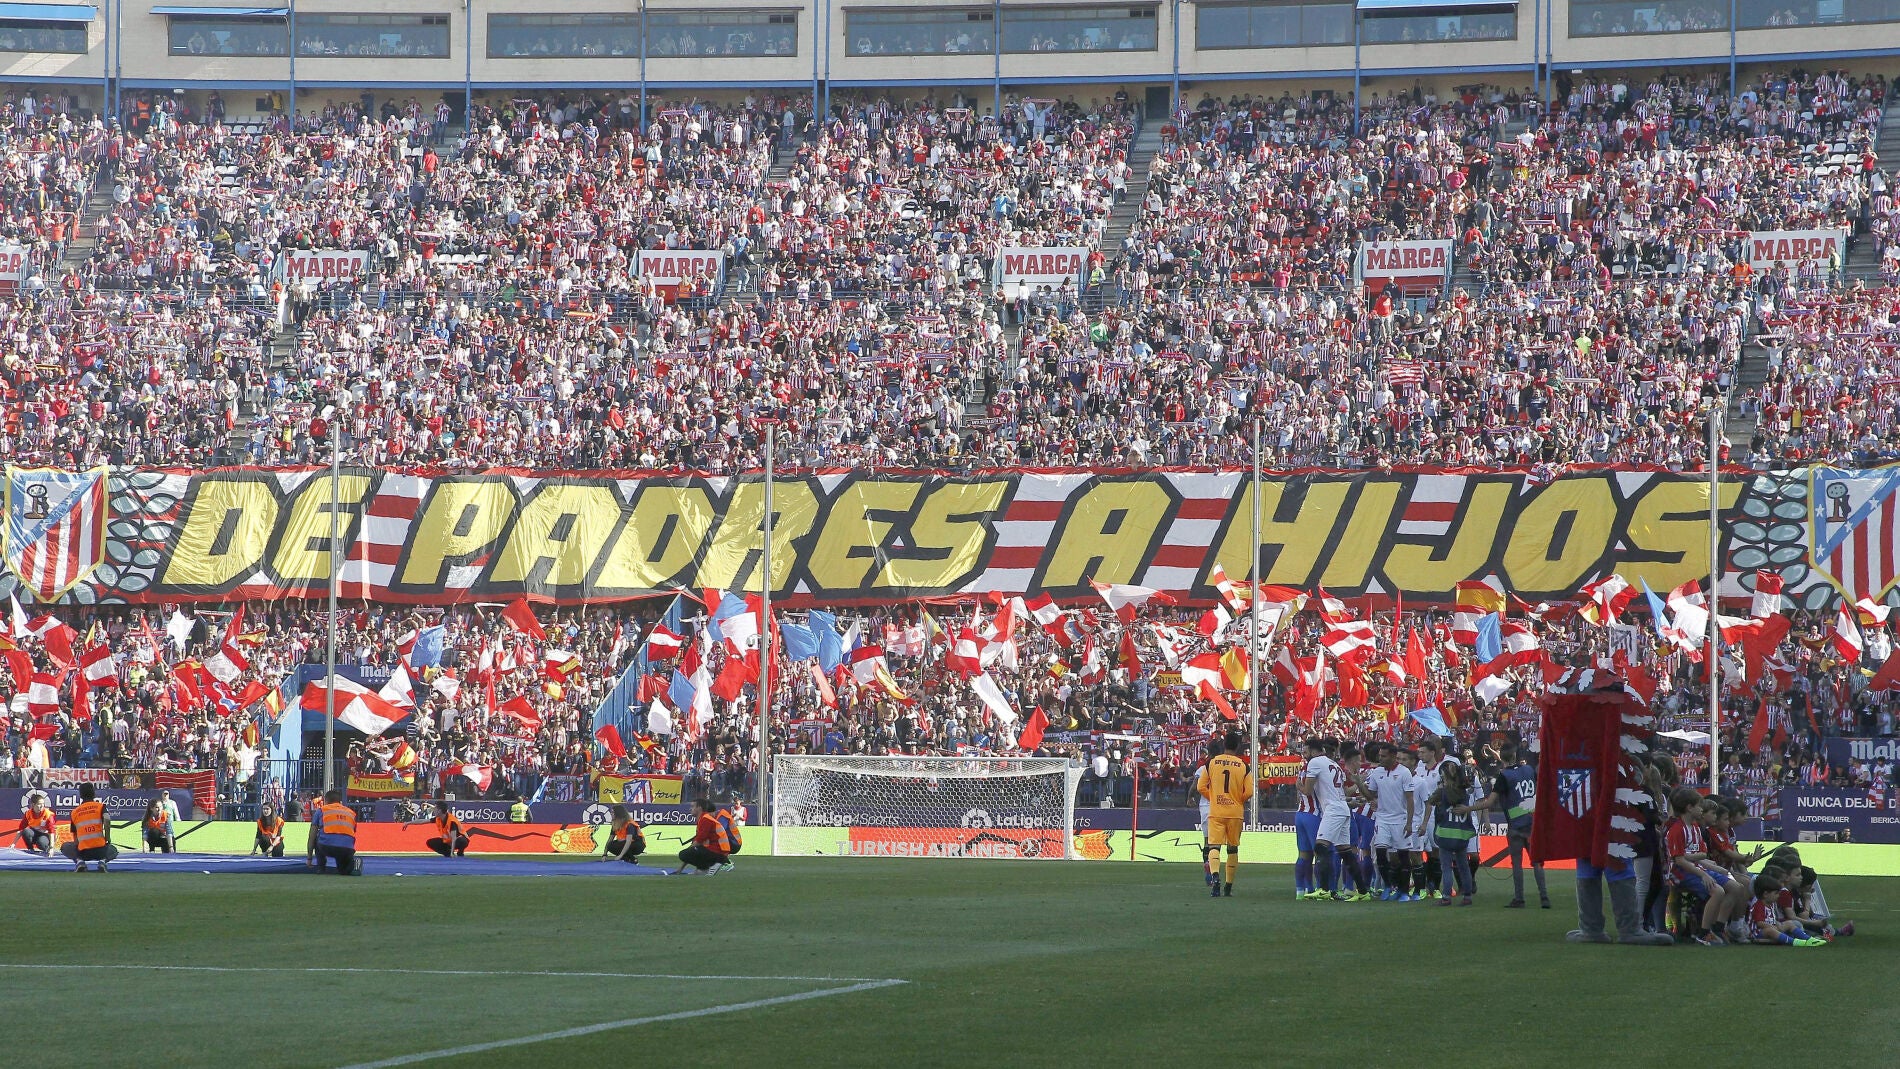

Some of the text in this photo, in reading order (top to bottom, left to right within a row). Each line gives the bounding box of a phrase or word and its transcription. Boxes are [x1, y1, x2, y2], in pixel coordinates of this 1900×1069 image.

[1366, 247, 1446, 269] MARCA
[1753, 237, 1837, 260] MARCA
[287, 257, 361, 277] MARCA
[642, 257, 717, 277] MARCA
[1005, 254, 1081, 275] MARCA
[156, 471, 1747, 598] DE PADRES A HIJOS
[1222, 769, 1230, 793] 1
[1516, 779, 1535, 798] 129
[655, 790, 680, 799] tour
[1797, 797, 1841, 808] NUNCA
[84, 825, 96, 833] 103
[836, 840, 1017, 859] TURKISH AIRLINES
